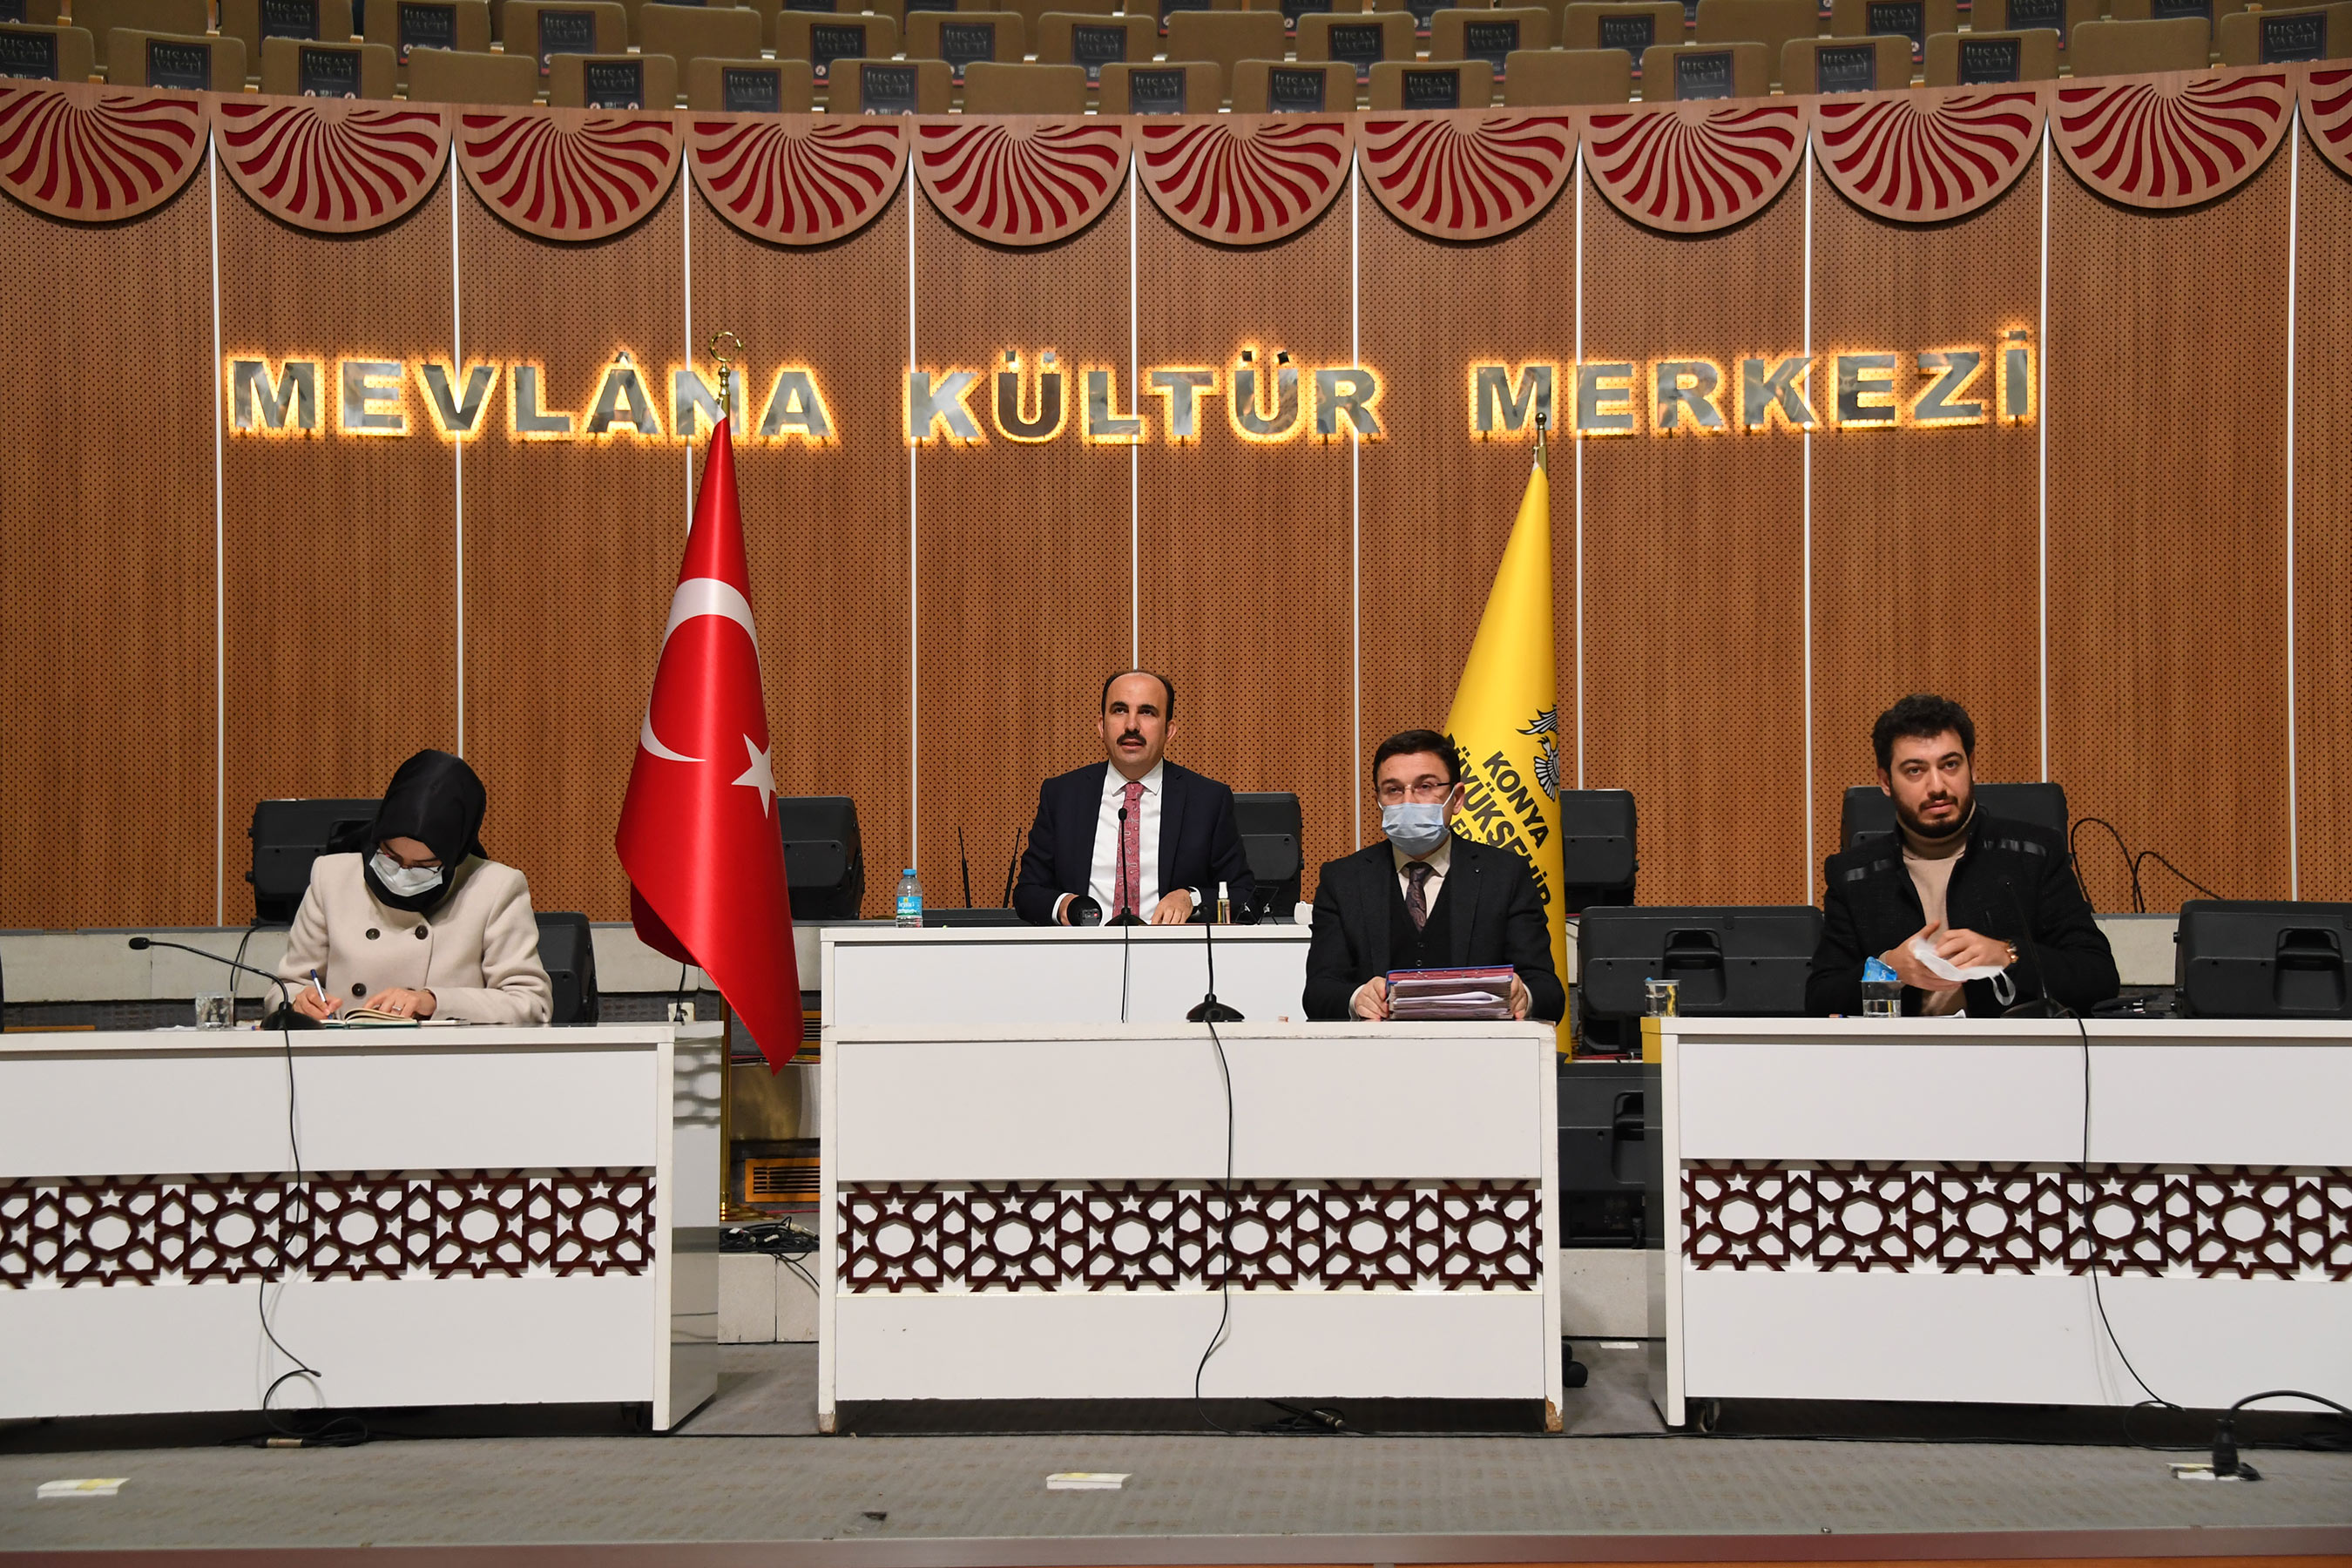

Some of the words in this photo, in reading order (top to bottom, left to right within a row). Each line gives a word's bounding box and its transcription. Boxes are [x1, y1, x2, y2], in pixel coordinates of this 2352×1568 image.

[232, 350, 833, 434] MEVLÂNA
[909, 350, 1383, 438] KÜLTÜR
[1477, 329, 2029, 431] MERKEZİ
[1482, 750, 1549, 849] KONYA
